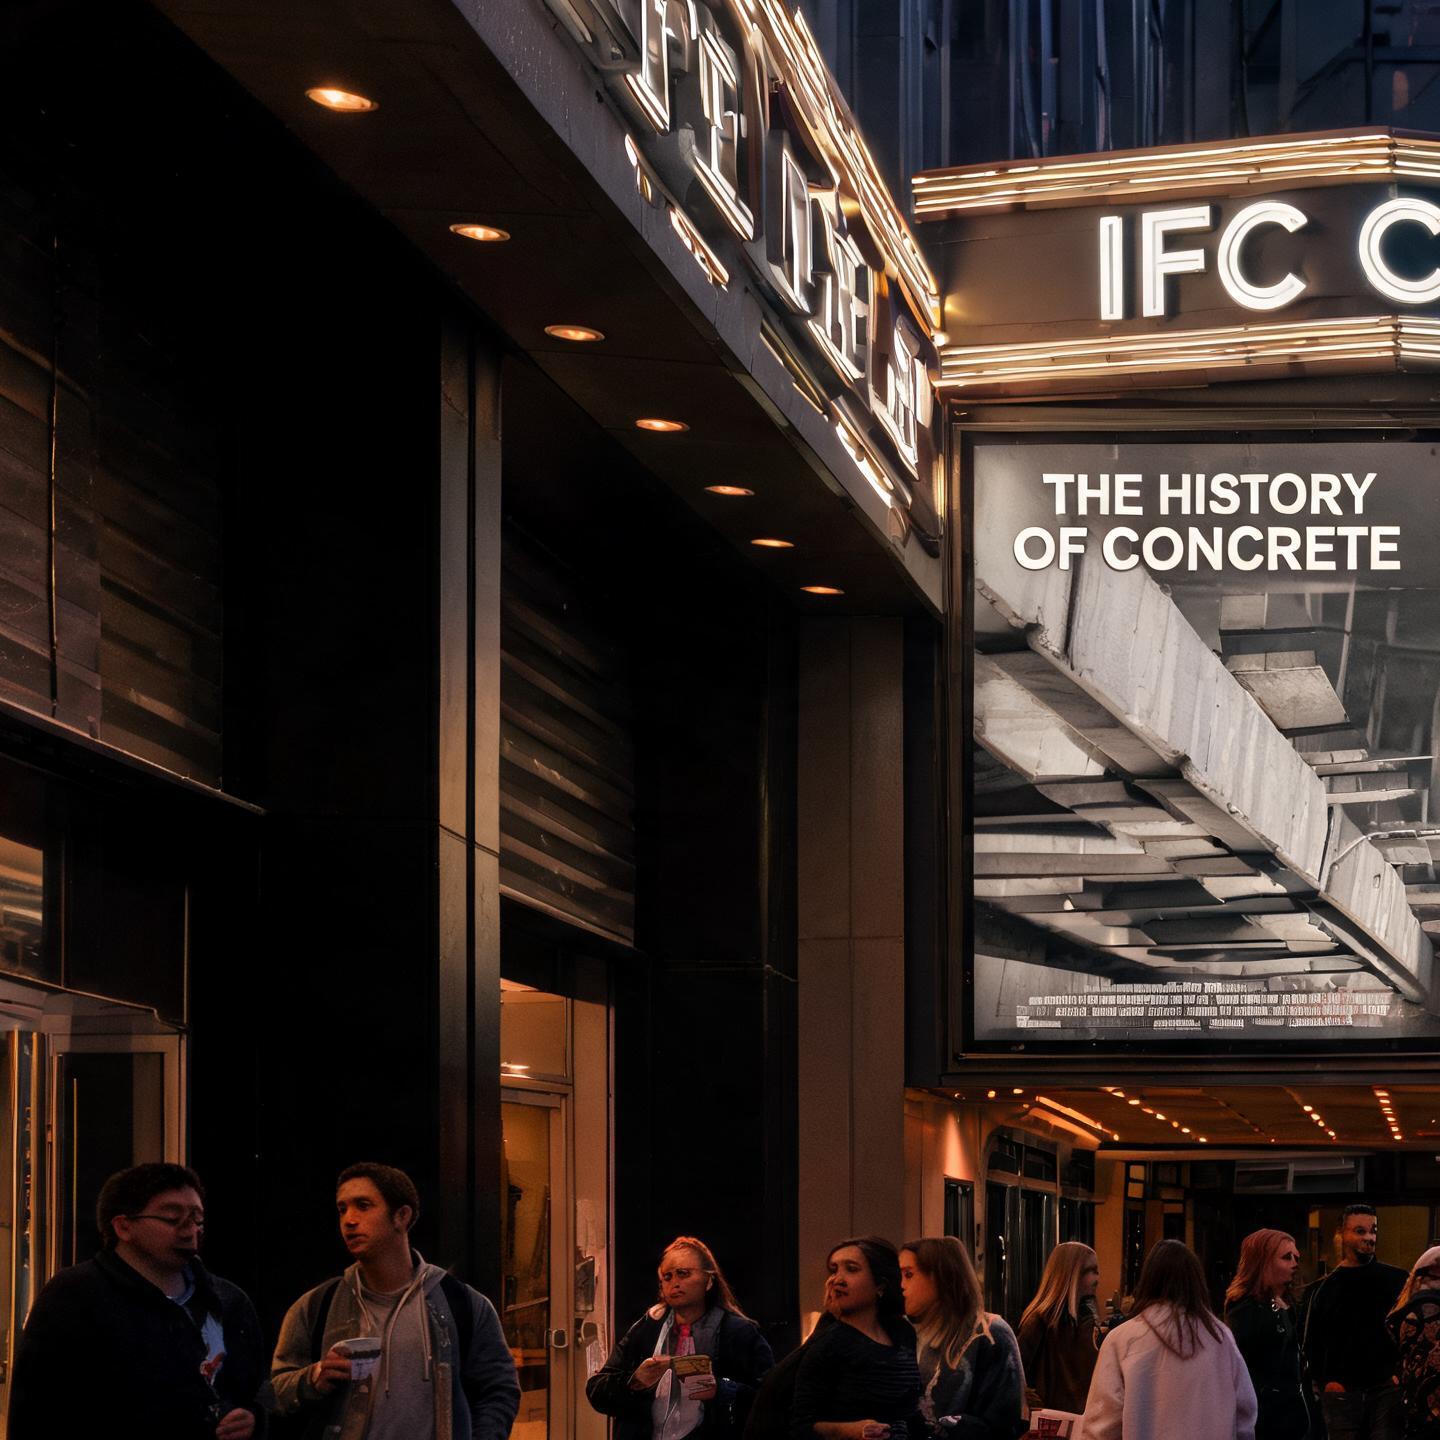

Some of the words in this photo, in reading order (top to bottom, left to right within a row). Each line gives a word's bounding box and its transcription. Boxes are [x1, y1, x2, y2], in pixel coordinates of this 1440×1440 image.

[1098, 200, 1308, 320] IFC
[1042, 473, 1143, 516] THE
[1159, 473, 1378, 516] HISTORY
[1013, 526, 1088, 571] OF
[1102, 525, 1401, 572] CONCRETE
